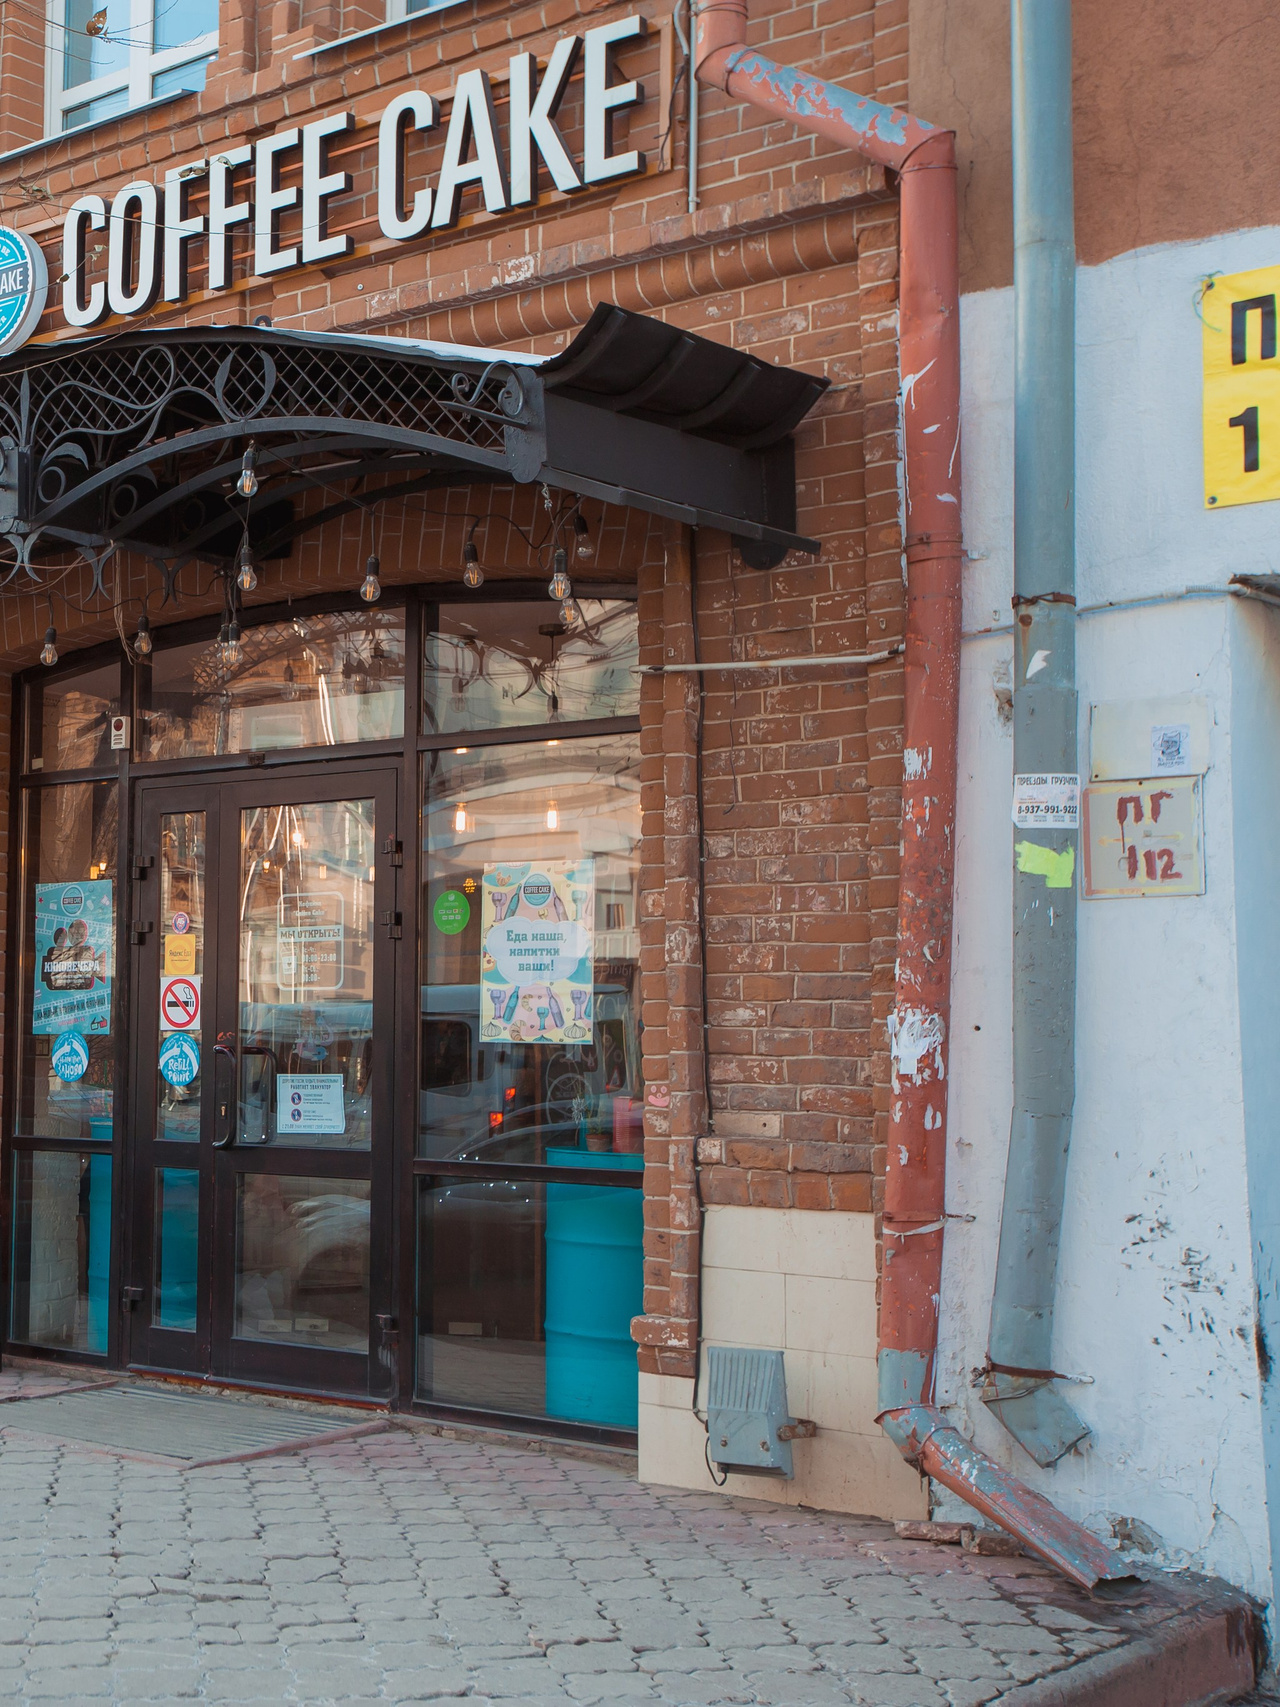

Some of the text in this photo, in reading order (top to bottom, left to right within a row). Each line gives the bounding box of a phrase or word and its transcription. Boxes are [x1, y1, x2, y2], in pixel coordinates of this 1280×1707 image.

[62, 14, 646, 327] COFFEE CAKE
[0, 246, 11, 257] BE
[1017, 804, 1078, 815] 8-937-991-9222
[524, 885, 550, 895] COFFEE CAKE
[281, 930, 295, 939] МЫ
[506, 930, 567, 944] Еда наша,
[509, 946, 560, 956] напитки
[44, 960, 100, 973] КИНОВЕЧЕРА
[518, 959, 555, 971] ваши!
